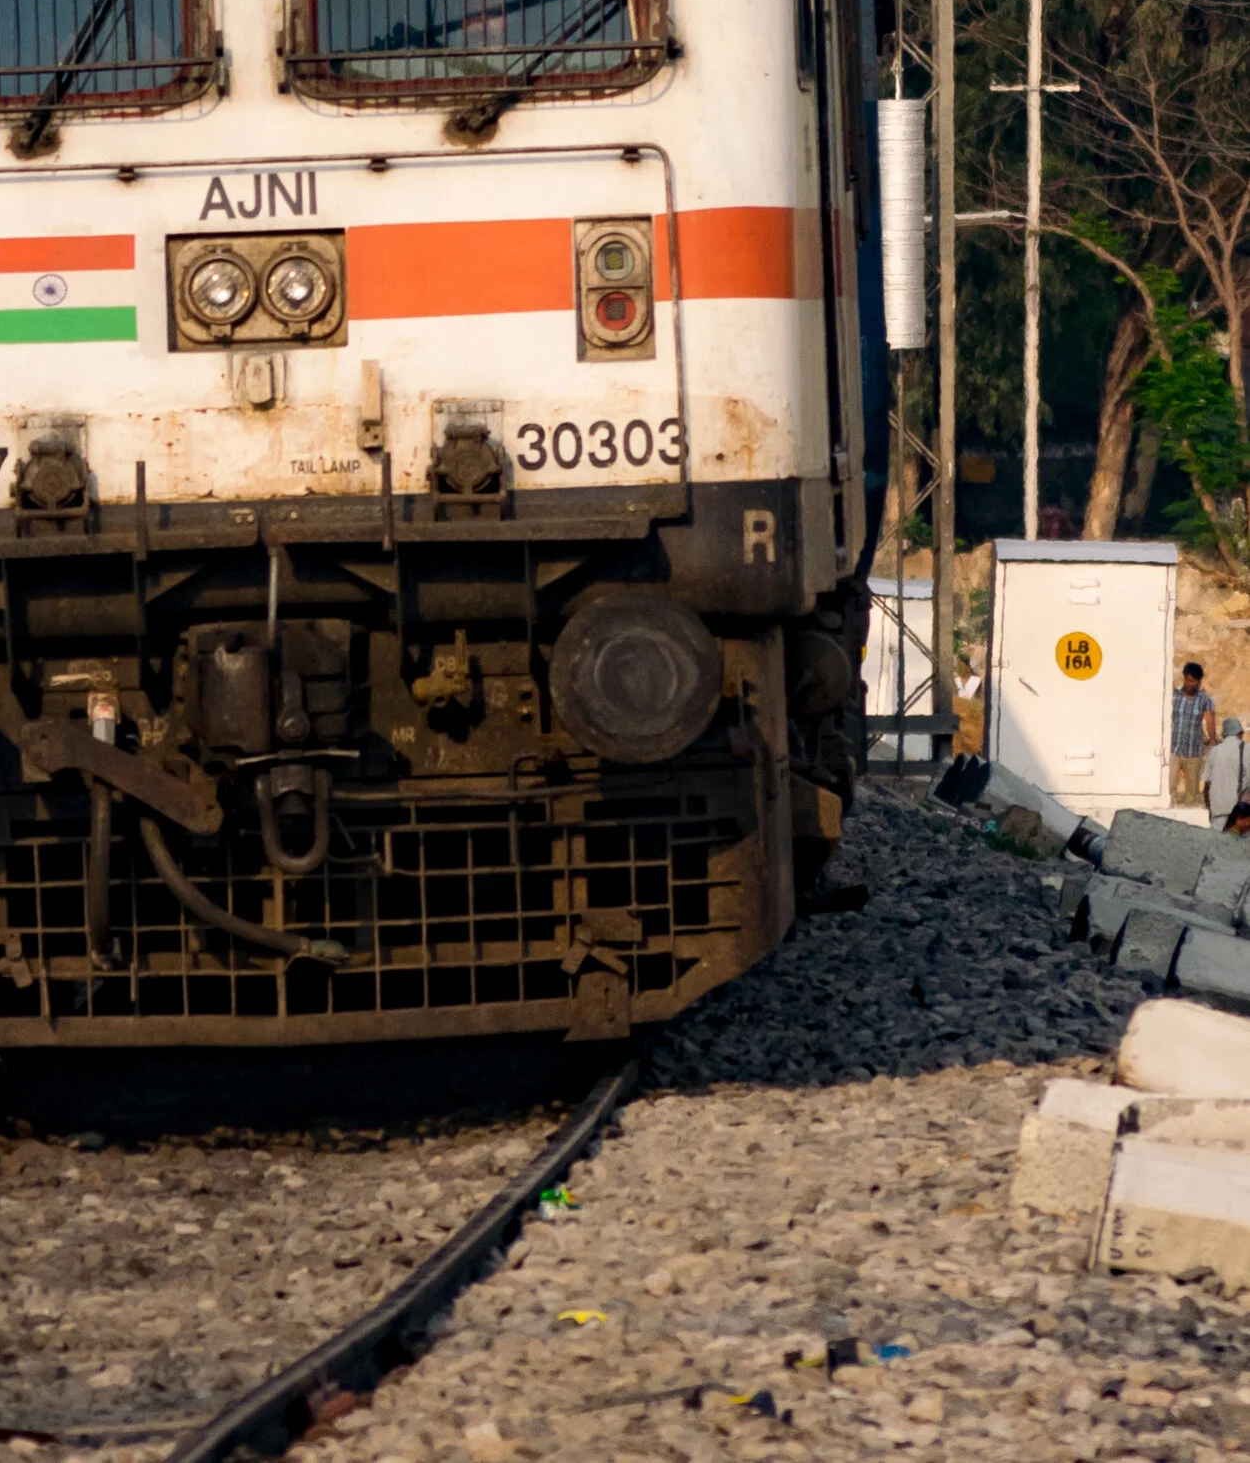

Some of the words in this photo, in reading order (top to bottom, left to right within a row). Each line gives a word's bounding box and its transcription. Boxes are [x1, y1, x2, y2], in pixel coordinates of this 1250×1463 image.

[199, 171, 318, 221] AJNI
[517, 417, 689, 471] 30303
[290, 460, 316, 475] TAIL
[321, 460, 361, 475] LAMP
[742, 509, 776, 565] R
[1065, 655, 1092, 670] 16A
[1067, 640, 1089, 654] LB
